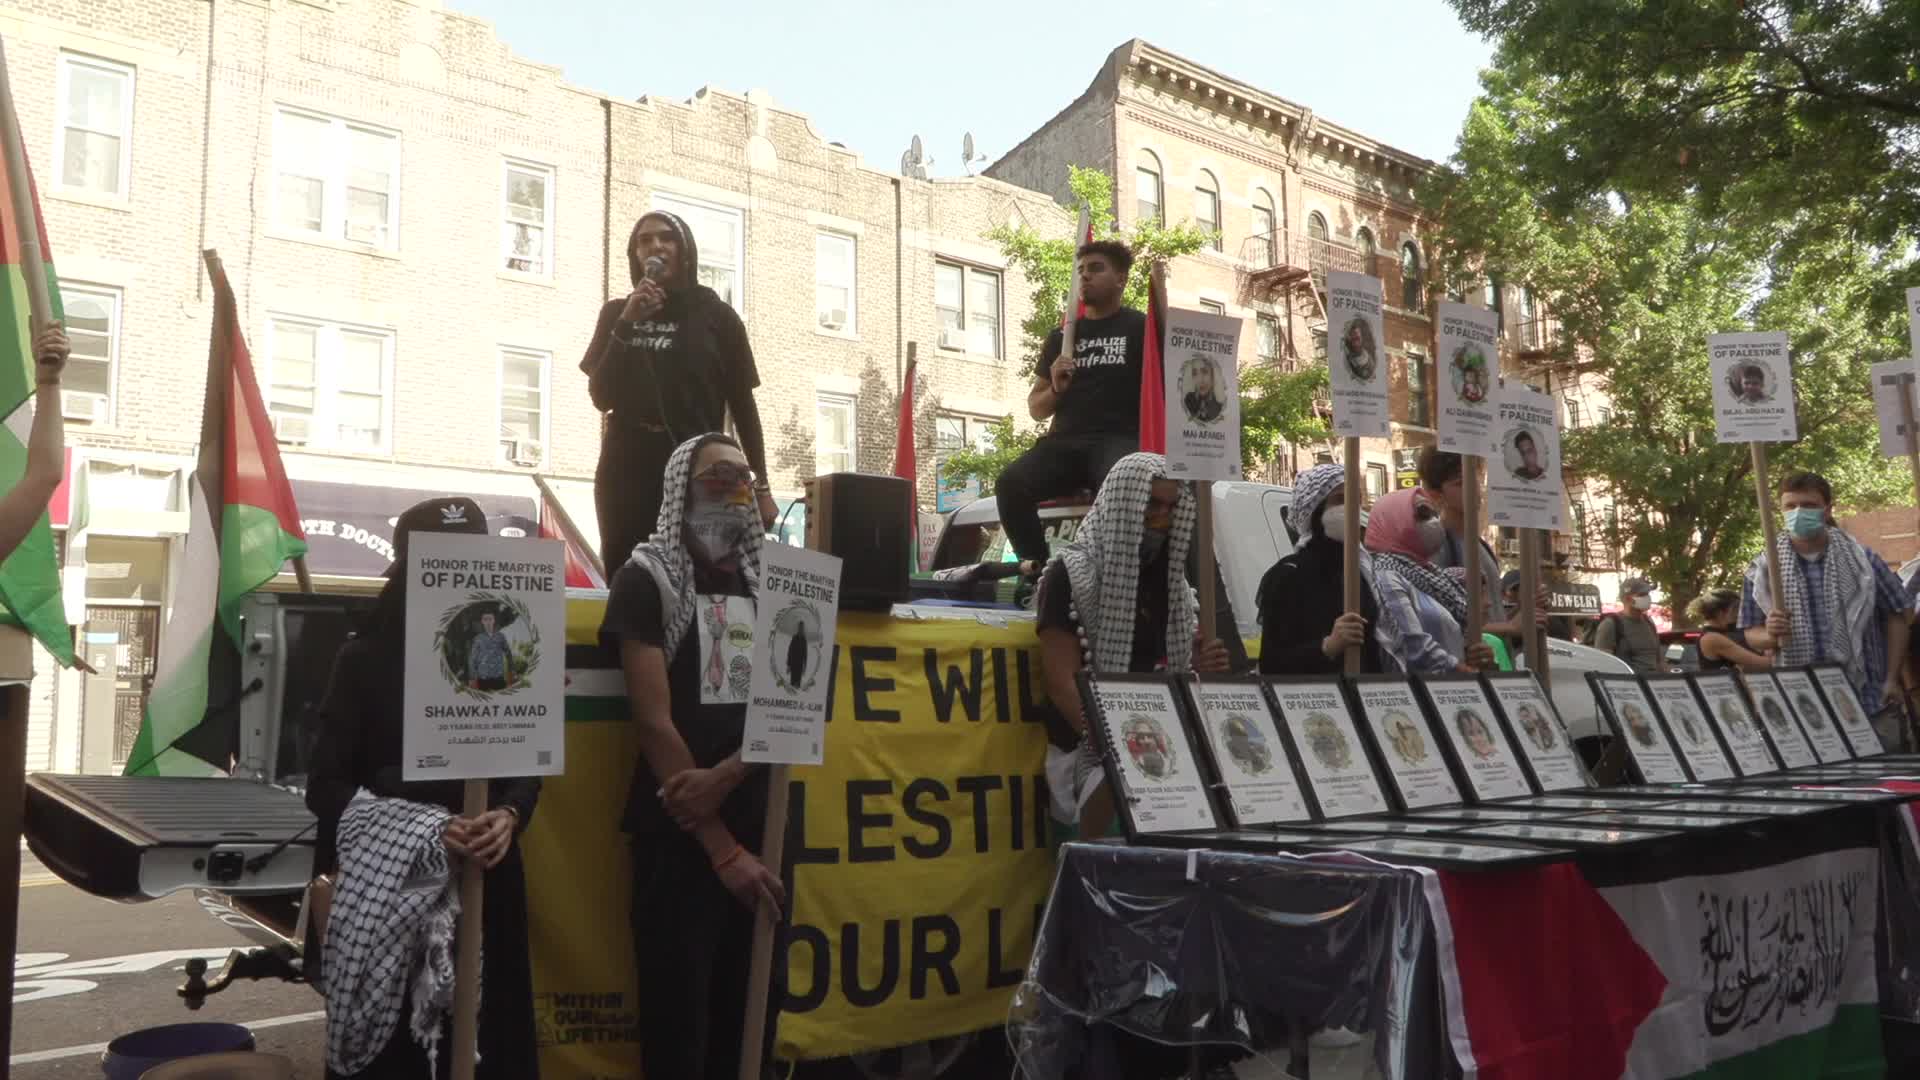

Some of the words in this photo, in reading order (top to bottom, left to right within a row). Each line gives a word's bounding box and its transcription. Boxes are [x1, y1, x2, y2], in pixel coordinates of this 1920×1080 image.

[1332, 297, 1345, 309] OF
[1346, 299, 1380, 315] PALESTINE
[1443, 324, 1455, 336] OF
[1456, 326, 1494, 345] PALESTINE
[1104, 346, 1127, 355] THE
[1171, 336, 1185, 348] OF
[1185, 338, 1233, 355] PALESTINE
[1714, 350, 1728, 359] OF
[1729, 348, 1782, 358] PALESTINE
[1508, 411, 1553, 426] PALESTINE
[421, 558, 469, 570] HONOR
[472, 560, 497, 571] THE
[499, 562, 555, 574] MARTYRS
[767, 564, 793, 578] HONOR
[795, 569, 809, 581] THE
[421, 572, 449, 588] OF
[453, 573, 553, 592] PALESTINE
[766, 576, 781, 592] OF
[782, 579, 833, 604] PALESTINE
[1551, 591, 1598, 608] JEWELRY
[753, 696, 798, 710] MOHAMMED
[1104, 700, 1117, 711] OF
[1118, 701, 1167, 712] PALESTINE
[1203, 701, 1214, 711] OF
[1215, 701, 1261, 711] PALESTINE
[1286, 700, 1296, 709] OF
[1296, 700, 1339, 710] PALESTINE
[425, 705, 499, 718] SHAWKAT
[503, 704, 548, 717] AWAD
[450, 723, 473, 731] YEARS
[783, 914, 961, 1015] OUR
[554, 992, 624, 1008] WITHIN
[554, 1010, 592, 1025] OUR
